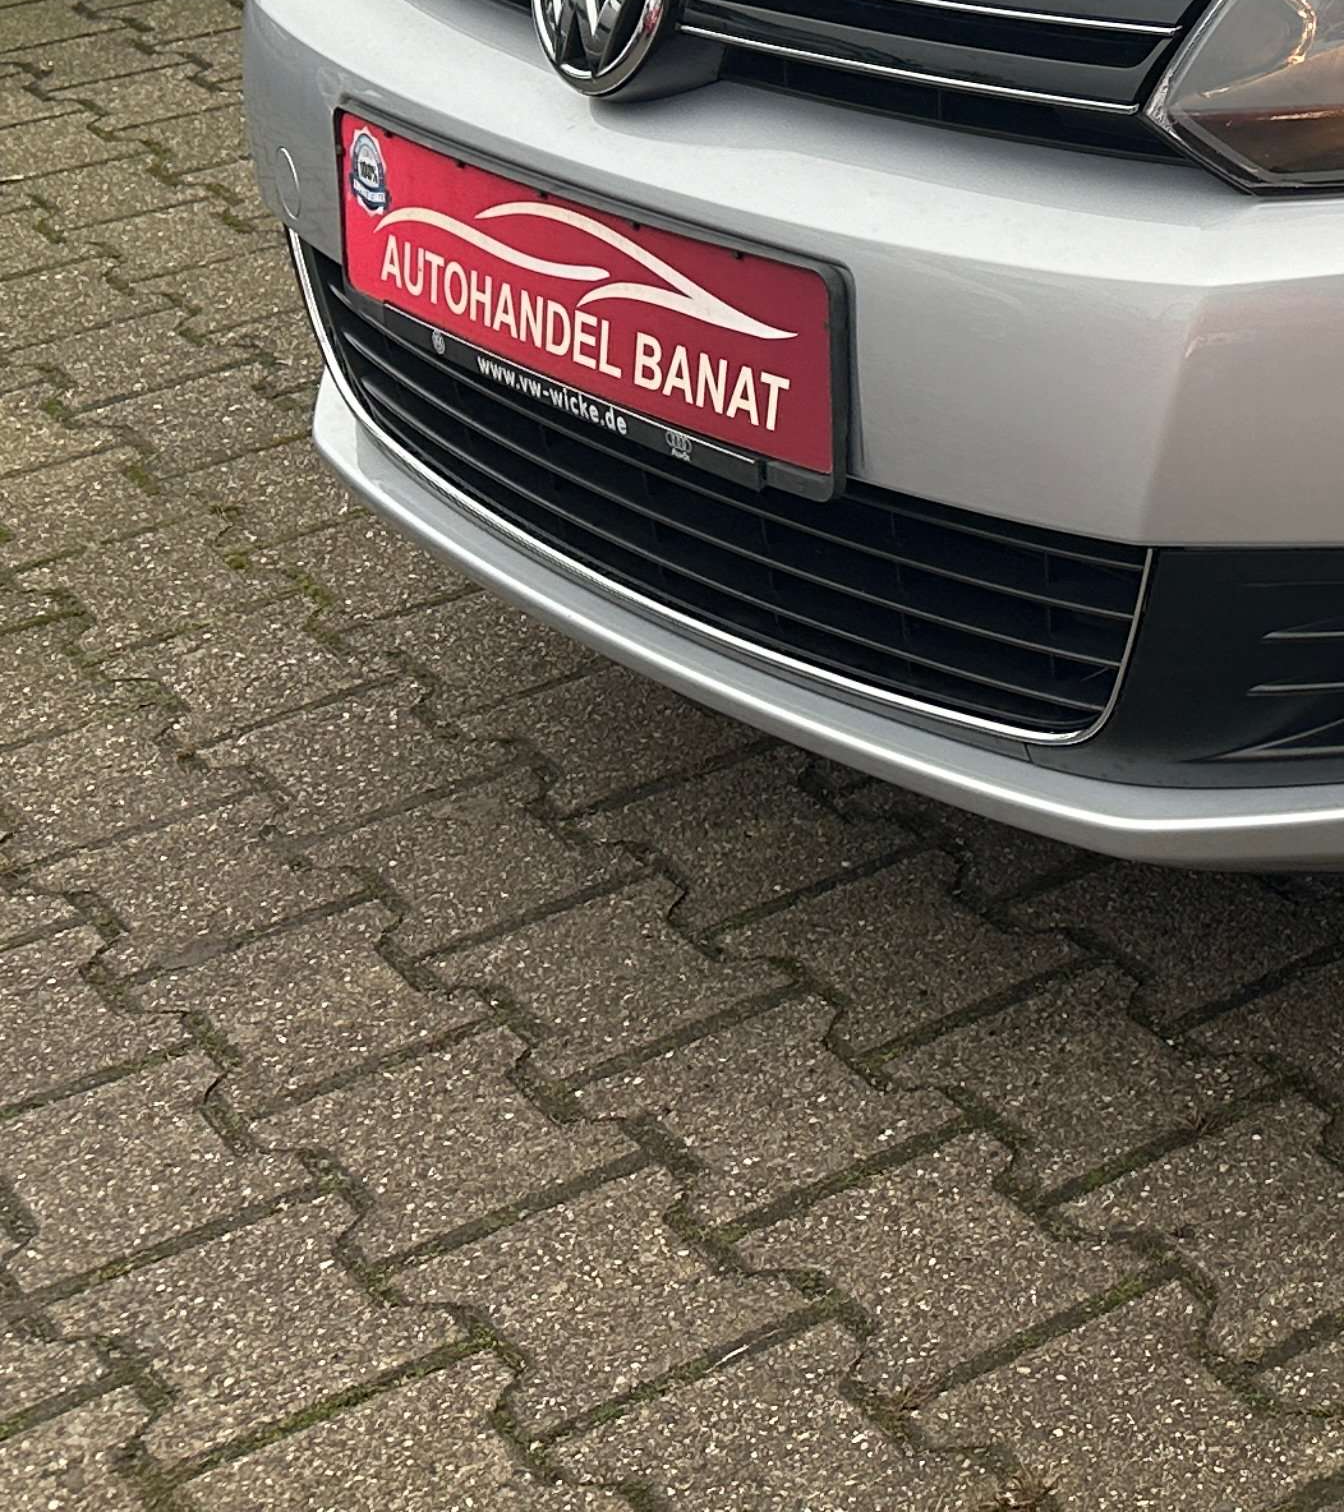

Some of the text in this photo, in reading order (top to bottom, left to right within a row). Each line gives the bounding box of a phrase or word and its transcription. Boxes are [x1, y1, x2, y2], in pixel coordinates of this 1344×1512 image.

[380, 234, 791, 432] AUTOHANDEL BANAT
[476, 355, 628, 436] www.vw-wicke.de
